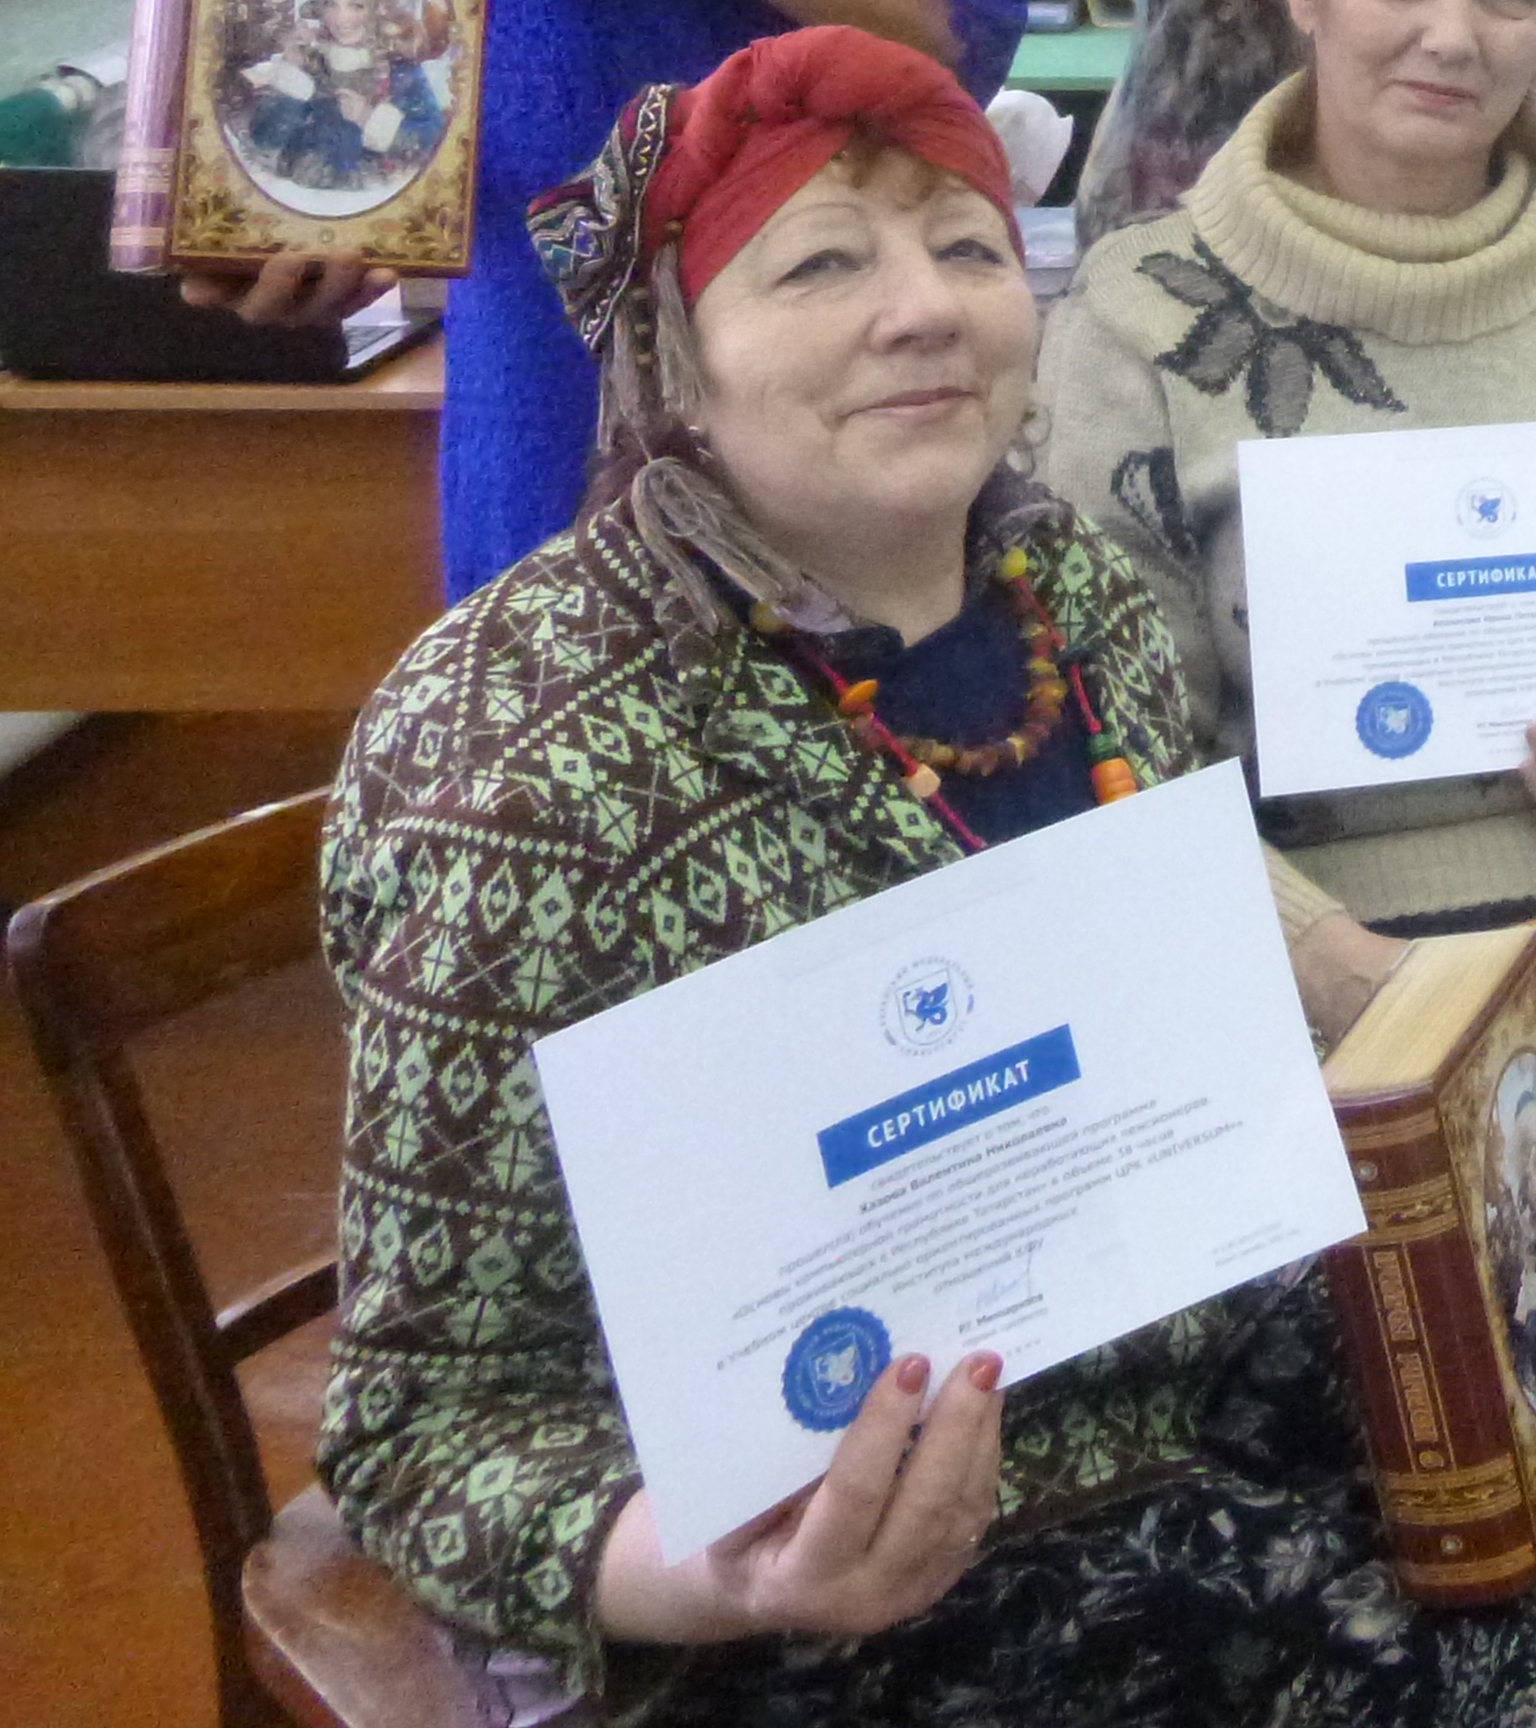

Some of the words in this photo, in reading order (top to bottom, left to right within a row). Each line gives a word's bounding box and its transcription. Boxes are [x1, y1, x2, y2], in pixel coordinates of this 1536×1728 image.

[866, 1059, 1031, 1149] СЕРТИФИКАТ
[910, 1152, 980, 1190] Валентина
[986, 1116, 1066, 1157] Николаевна
